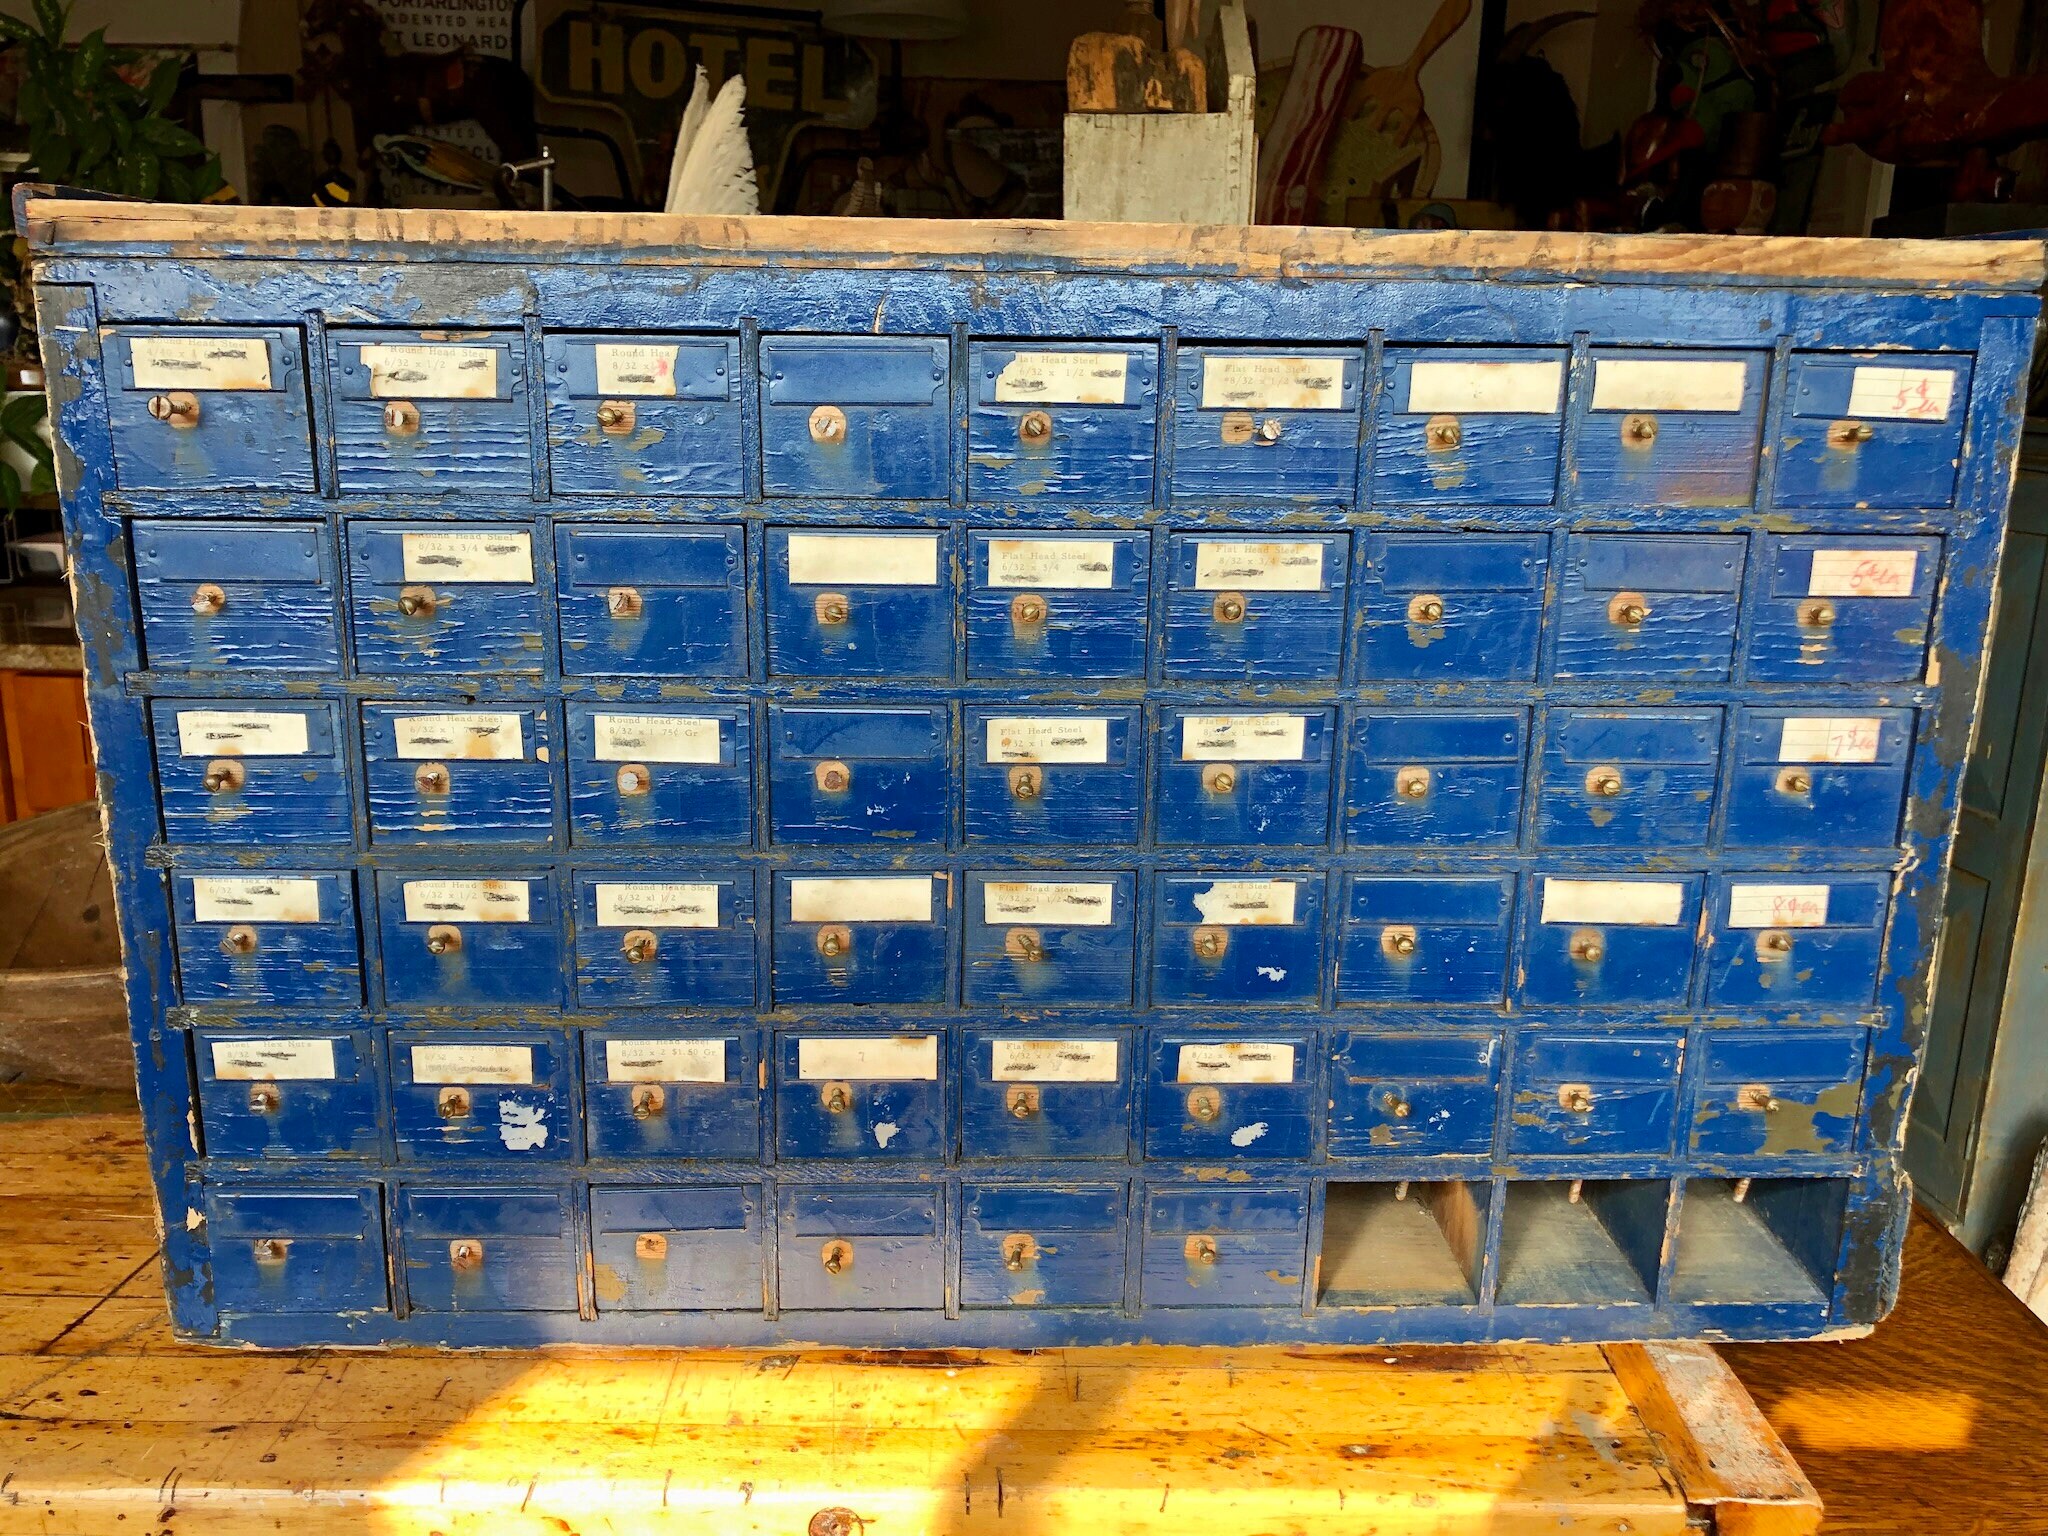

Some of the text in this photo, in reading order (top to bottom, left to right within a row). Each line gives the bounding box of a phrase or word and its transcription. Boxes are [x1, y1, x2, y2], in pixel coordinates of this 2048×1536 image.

[568, 19, 850, 115] HOTEL
[220, 341, 248, 349] Steel
[391, 346, 488, 358] Round Head Steel
[612, 349, 670, 357] Round Hea
[385, 359, 408, 367] 6/32
[427, 360, 445, 368] 1/2
[1041, 356, 1068, 364] Head
[1224, 364, 1311, 373] Flat Head Steel
[1271, 377, 1289, 385] 1/2
[461, 544, 478, 552] 3/4
[1216, 545, 1238, 553] Flat
[1275, 546, 1300, 554] Steel
[1002, 552, 1023, 560] Flat
[1030, 552, 1056, 560] Head
[610, 727, 632, 735] 8/32
[663, 728, 678, 736] 75¢
[1048, 896, 1062, 904] 1/2
